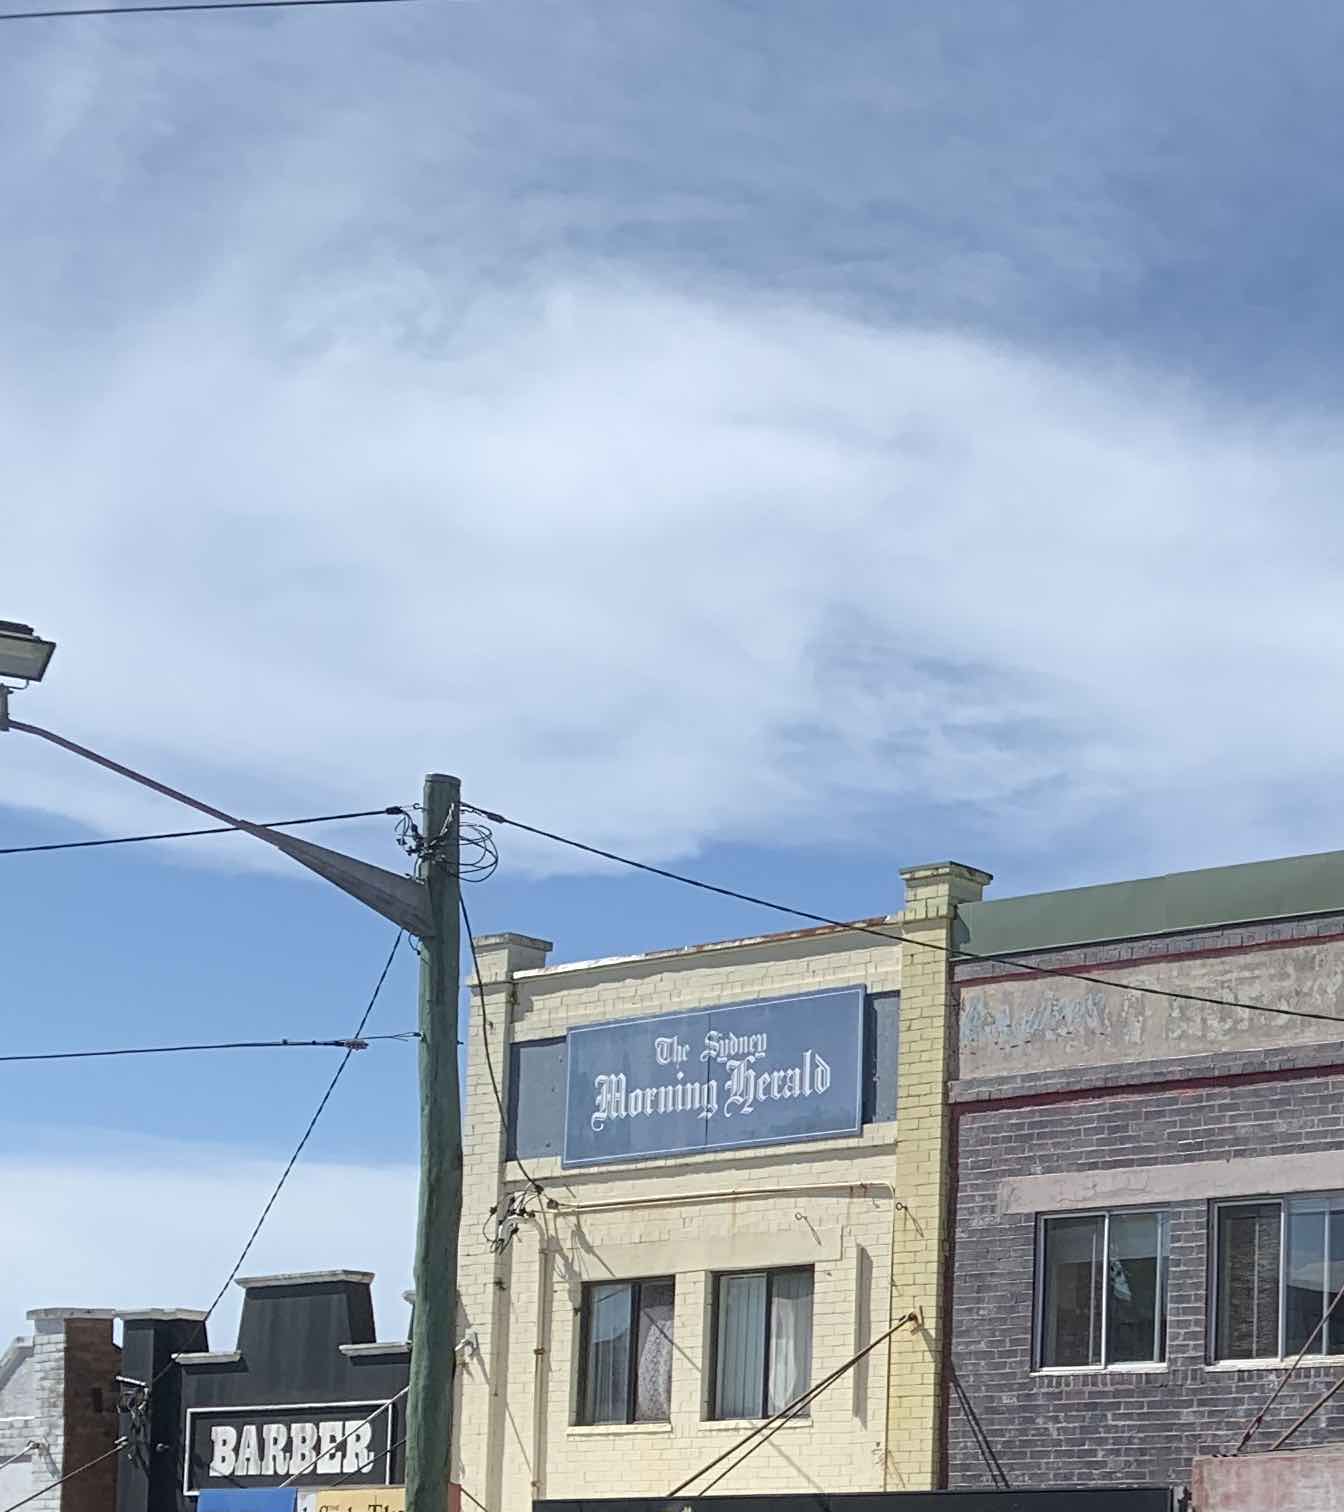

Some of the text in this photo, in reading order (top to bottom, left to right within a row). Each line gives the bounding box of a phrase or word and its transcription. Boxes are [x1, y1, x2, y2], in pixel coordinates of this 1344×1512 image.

[655, 1030, 767, 1068] The Sydney
[591, 1050, 831, 1131] Morning Herald
[209, 1420, 374, 1477] BARBER
